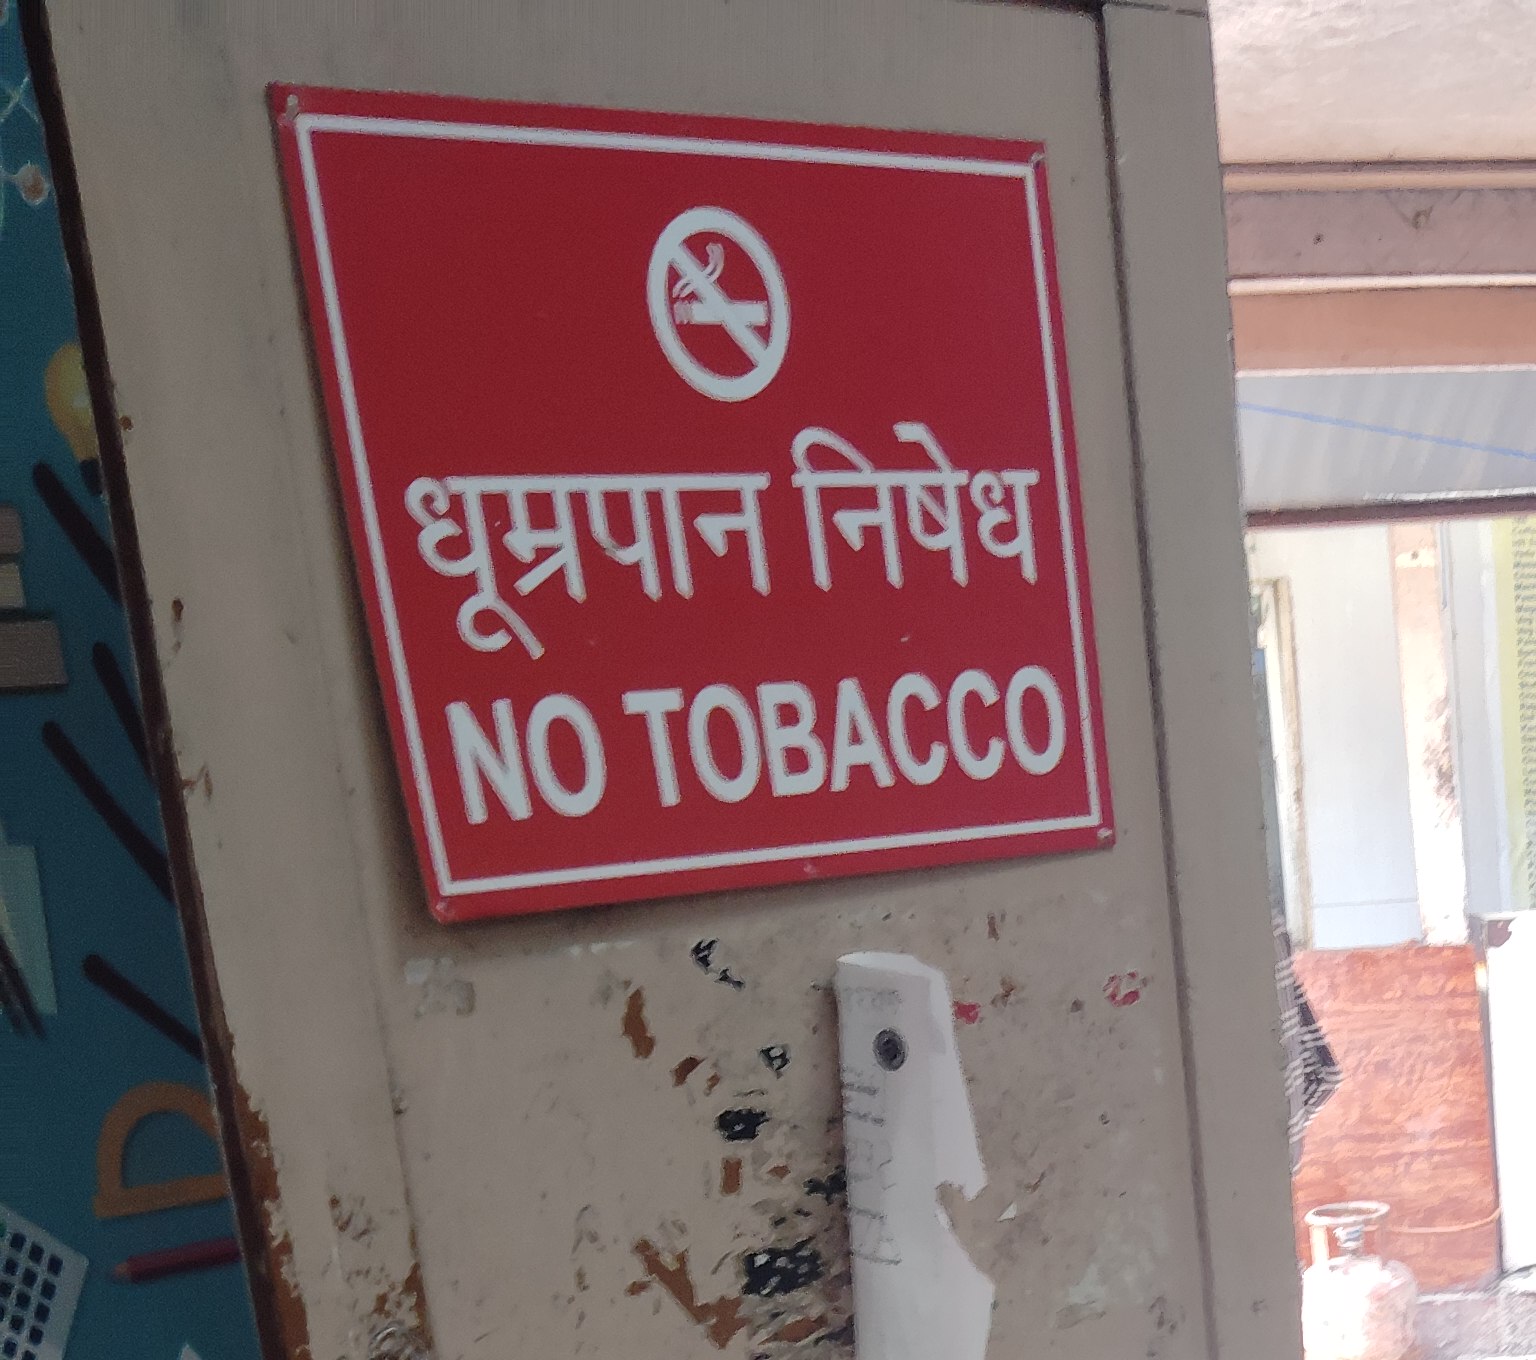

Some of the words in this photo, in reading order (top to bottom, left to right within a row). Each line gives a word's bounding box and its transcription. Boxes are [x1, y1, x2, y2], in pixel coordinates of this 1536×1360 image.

[405, 472, 771, 660] धूम्रपान
[790, 421, 1041, 593] निषेध
[445, 692, 608, 825] NO
[621, 664, 1067, 808] TOBACCO
